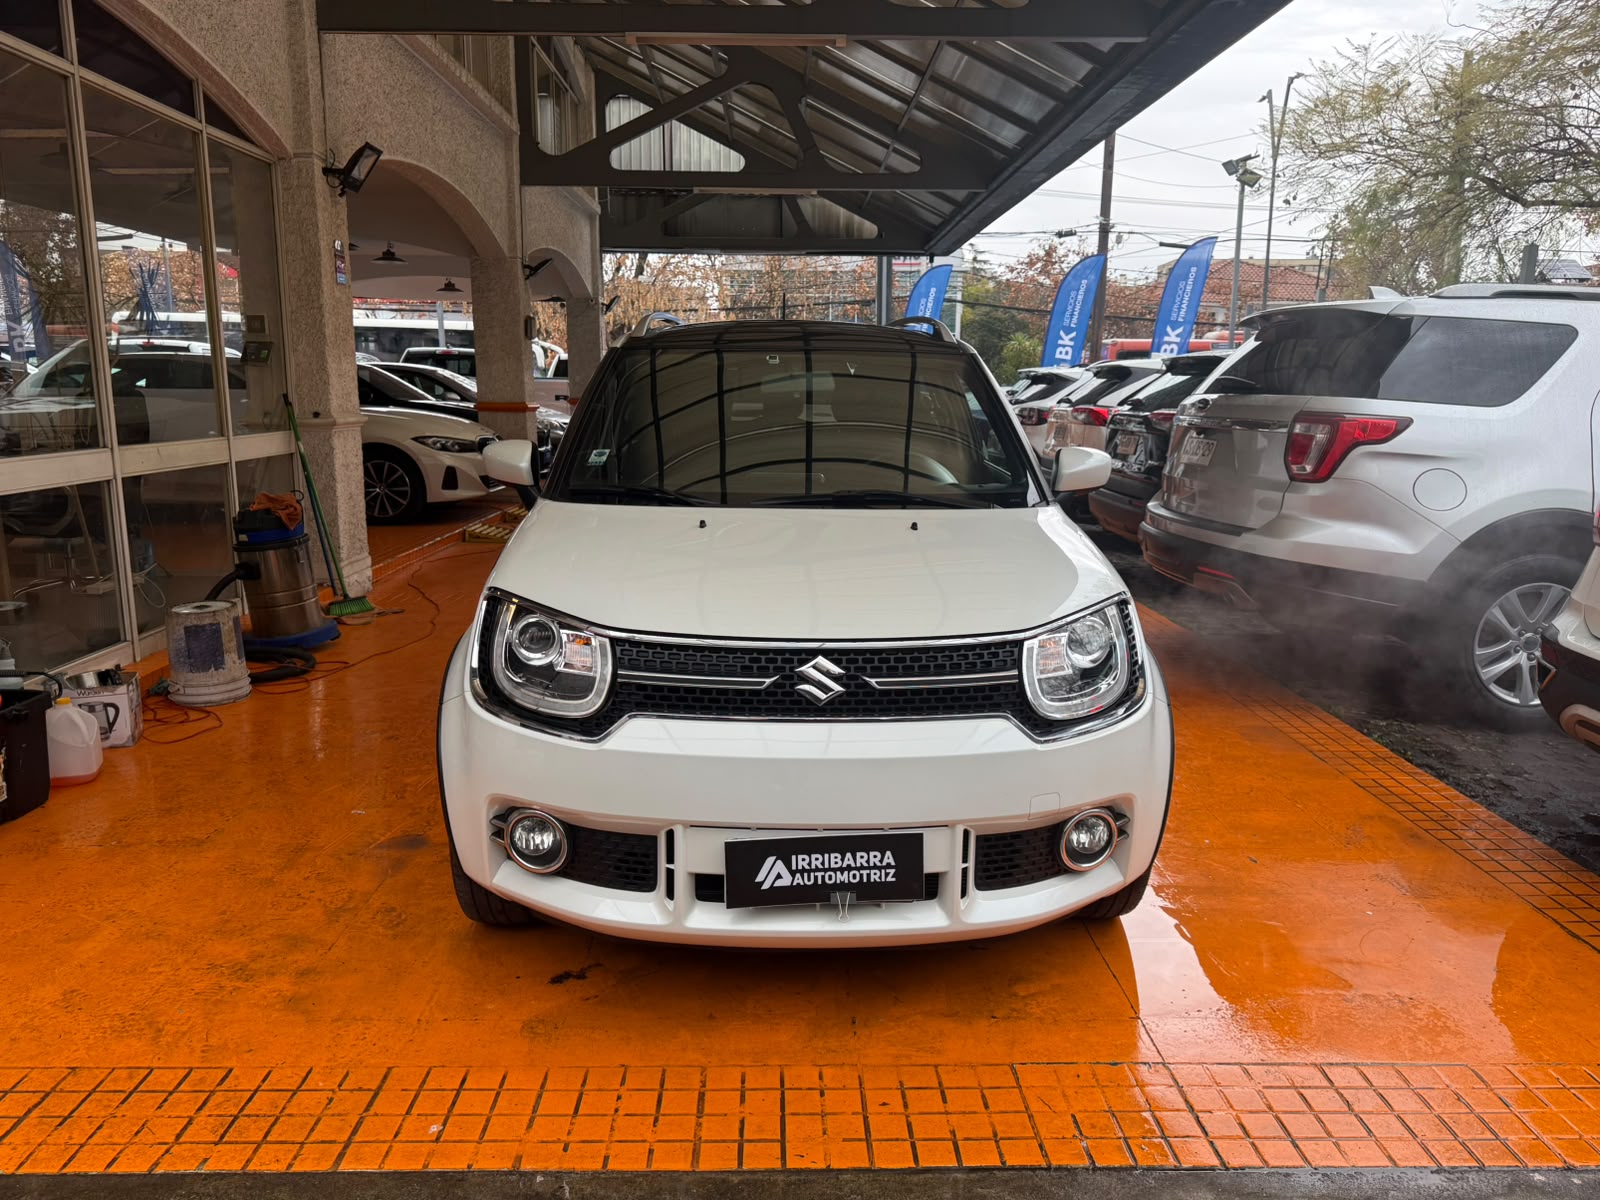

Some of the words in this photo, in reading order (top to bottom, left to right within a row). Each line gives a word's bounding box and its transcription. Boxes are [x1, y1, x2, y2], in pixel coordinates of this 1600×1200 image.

[1063, 290, 1077, 327] SERVICIOS
[1070, 279, 1088, 328] FINANCIEROS
[1171, 280, 1186, 321] SERVICIOS
[1178, 266, 1197, 322] FINANCIEROS
[1055, 329, 1077, 360] BK
[1161, 325, 1184, 356] BK
[791, 850, 896, 871] IRRIBARRA
[792, 868, 897, 886] AUTOMOTRIZ
